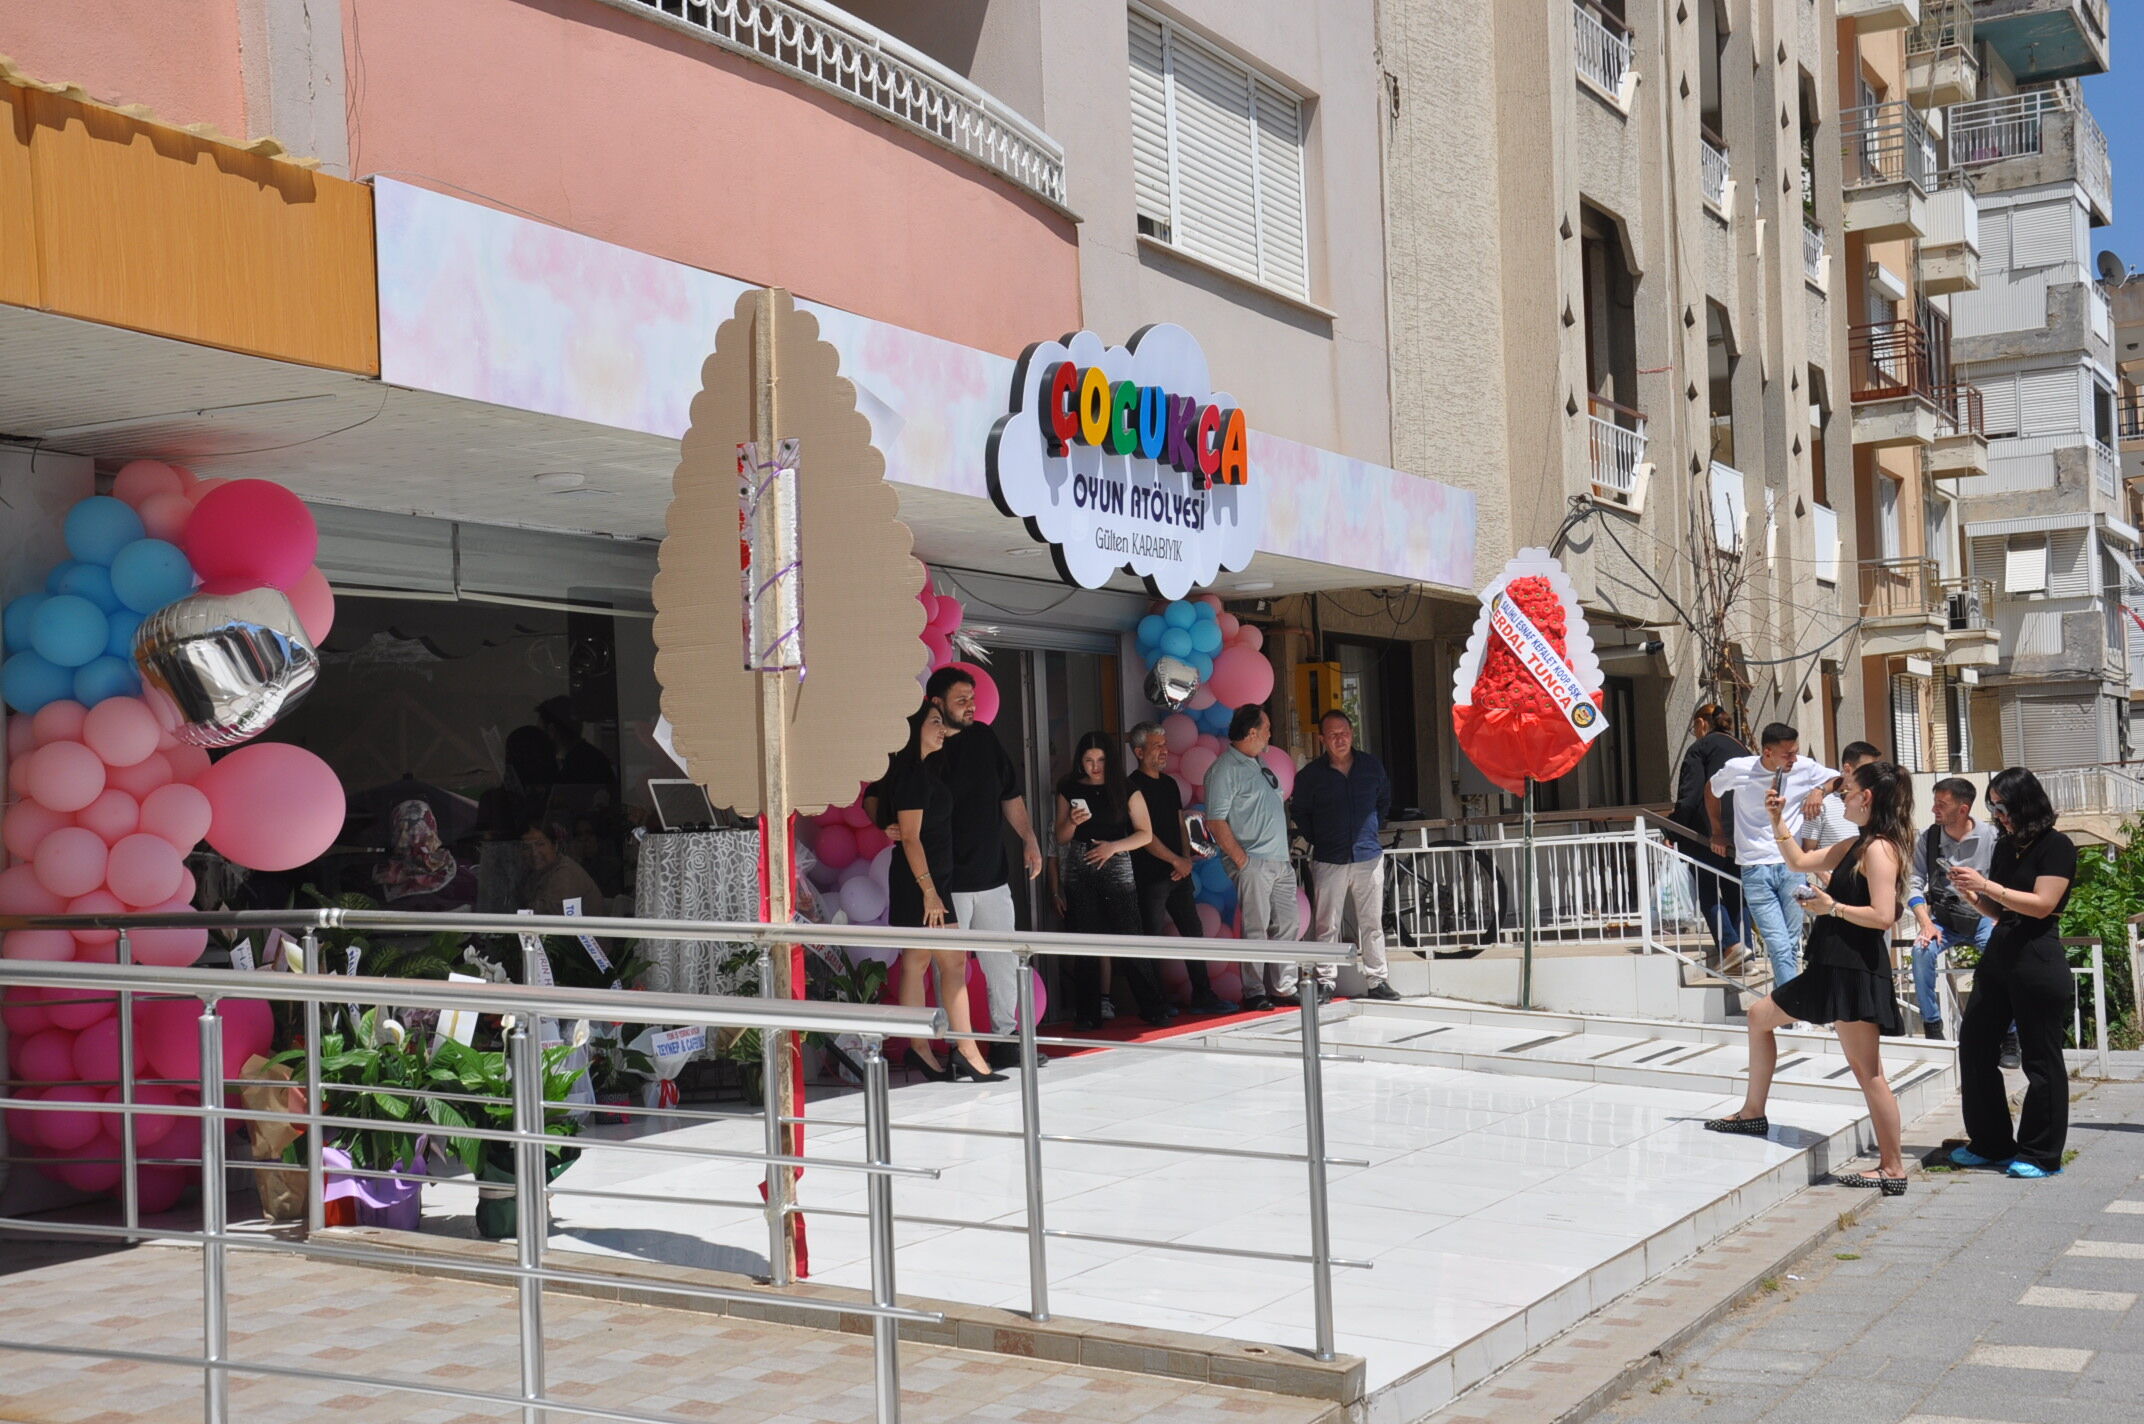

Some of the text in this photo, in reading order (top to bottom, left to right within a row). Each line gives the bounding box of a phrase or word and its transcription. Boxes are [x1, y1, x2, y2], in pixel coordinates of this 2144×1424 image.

[1051, 361, 1248, 490] ÇOCUKÇA
[1074, 474, 1205, 530] OYUN ATÖLYESİ
[1096, 527, 1182, 562] Gülten KARABIYIK
[1493, 609, 1574, 710] ERDAL TUNCA
[1515, 620, 1536, 641] ESNAF
[1531, 639, 1557, 668] KEFALET
